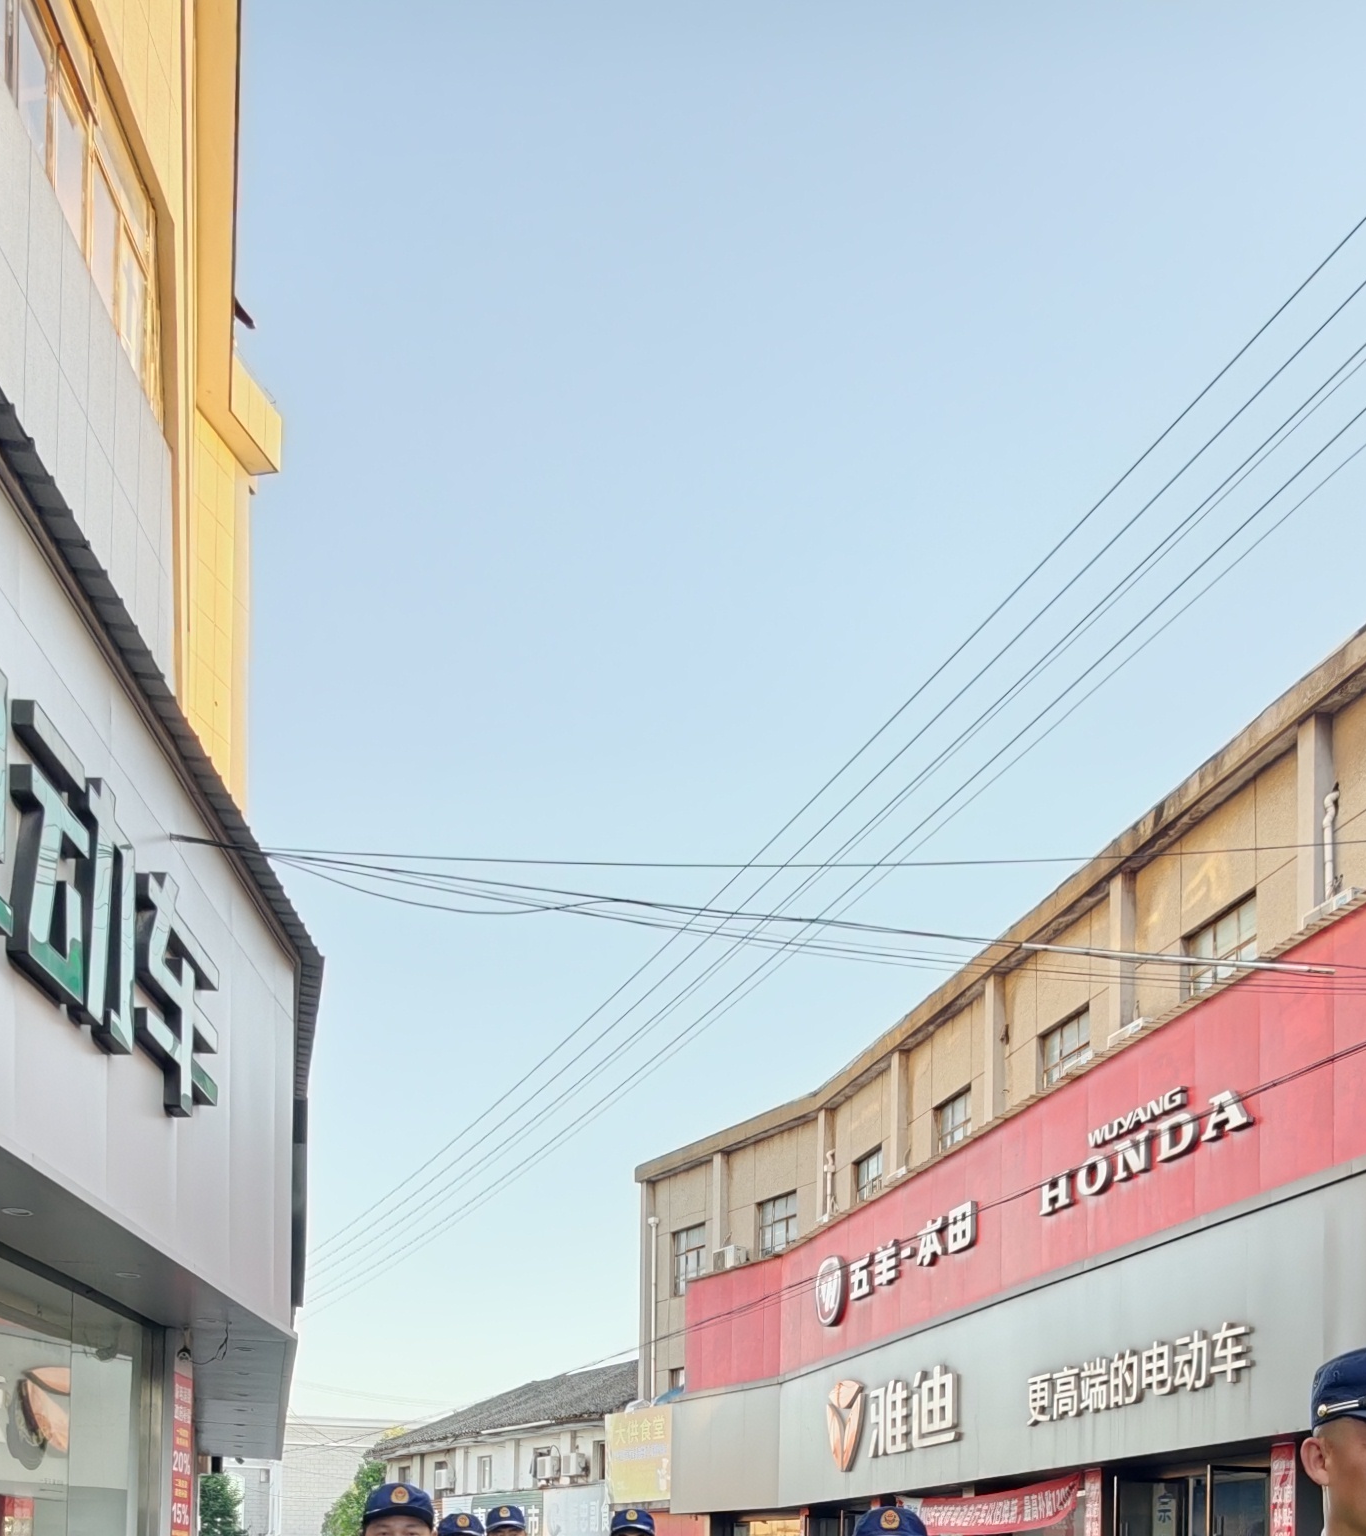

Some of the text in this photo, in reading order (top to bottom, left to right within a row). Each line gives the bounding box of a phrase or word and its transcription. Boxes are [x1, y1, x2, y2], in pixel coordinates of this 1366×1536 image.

[1039, 1090, 1255, 1216] HONDA
[1088, 1086, 1188, 1148] WUYANG
[869, 1365, 963, 1458] 雅迪
[1026, 1322, 1254, 1427] 更高端的电动车
